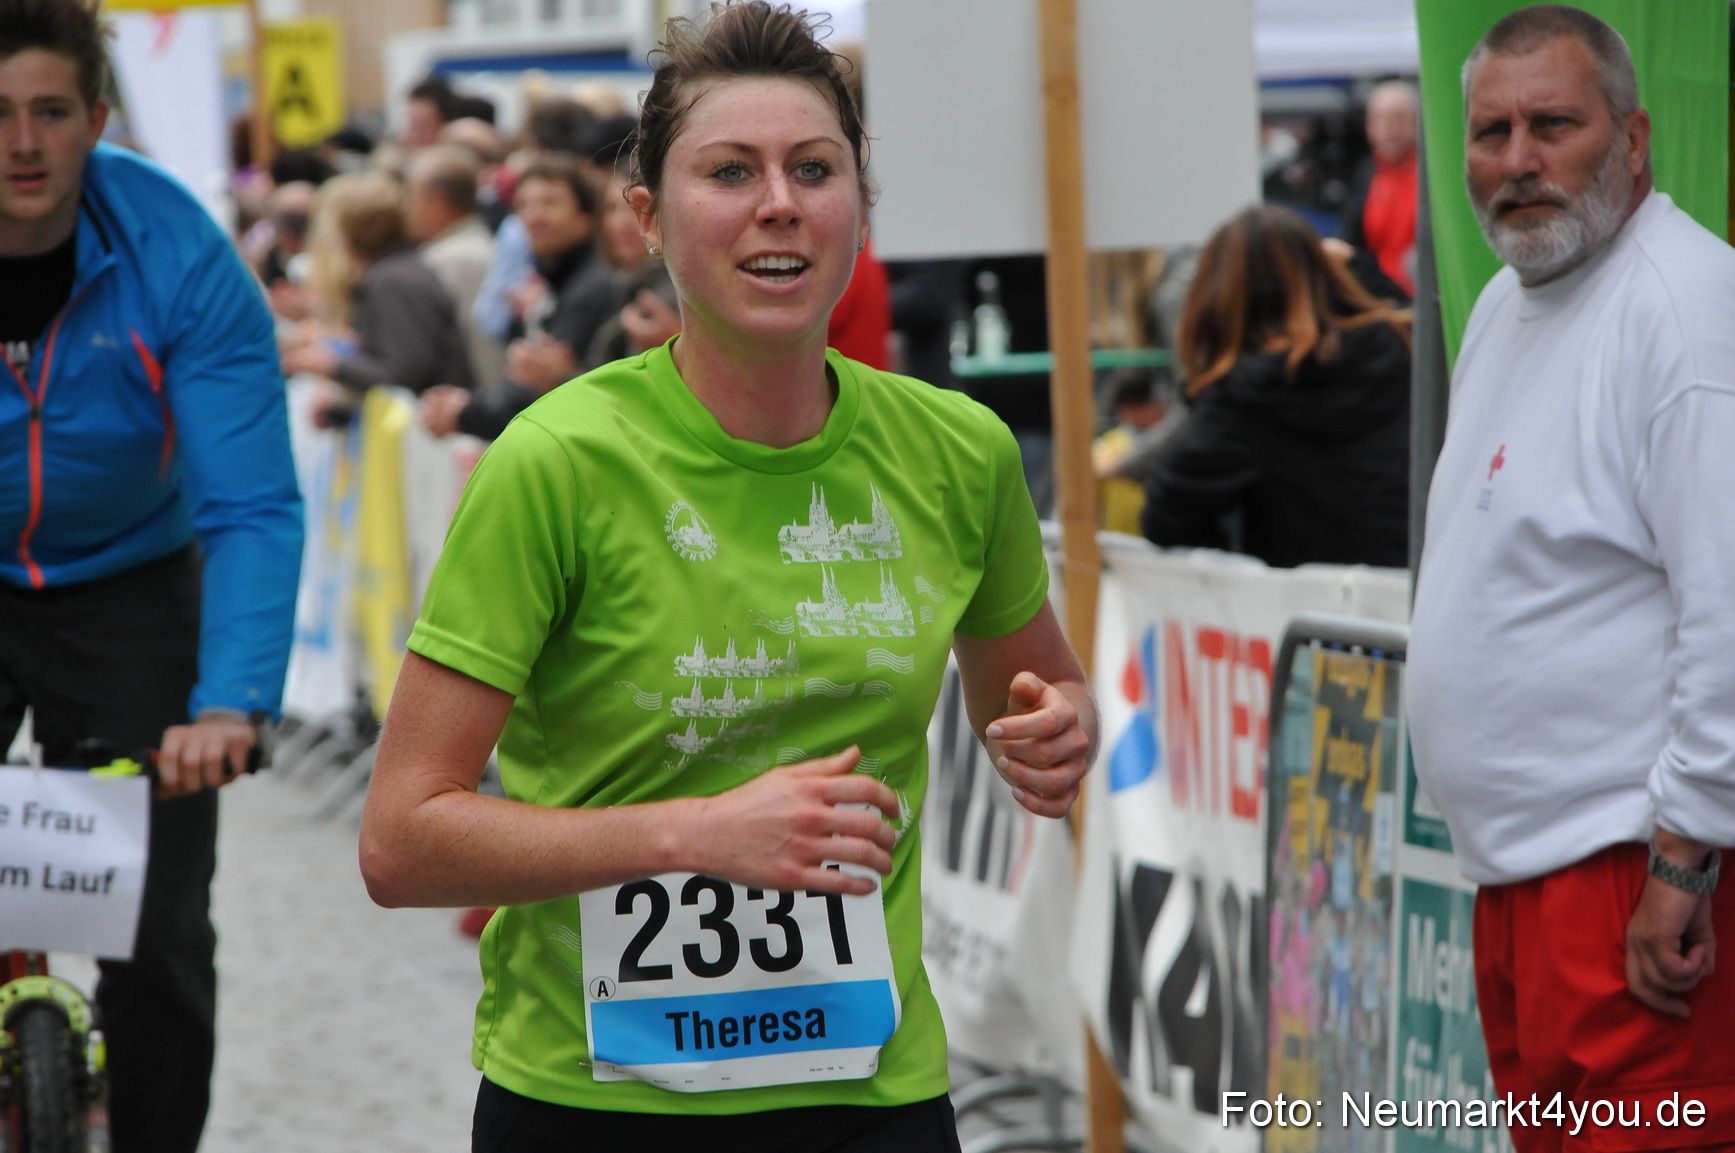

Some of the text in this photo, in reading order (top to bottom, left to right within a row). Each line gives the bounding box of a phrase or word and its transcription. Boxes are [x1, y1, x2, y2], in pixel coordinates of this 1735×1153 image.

[22, 801, 96, 834] Frau
[43, 864, 116, 894] Lauf
[614, 864, 854, 983] 2331
[597, 980, 609, 998] A
[665, 1007, 827, 1051] Theresa
